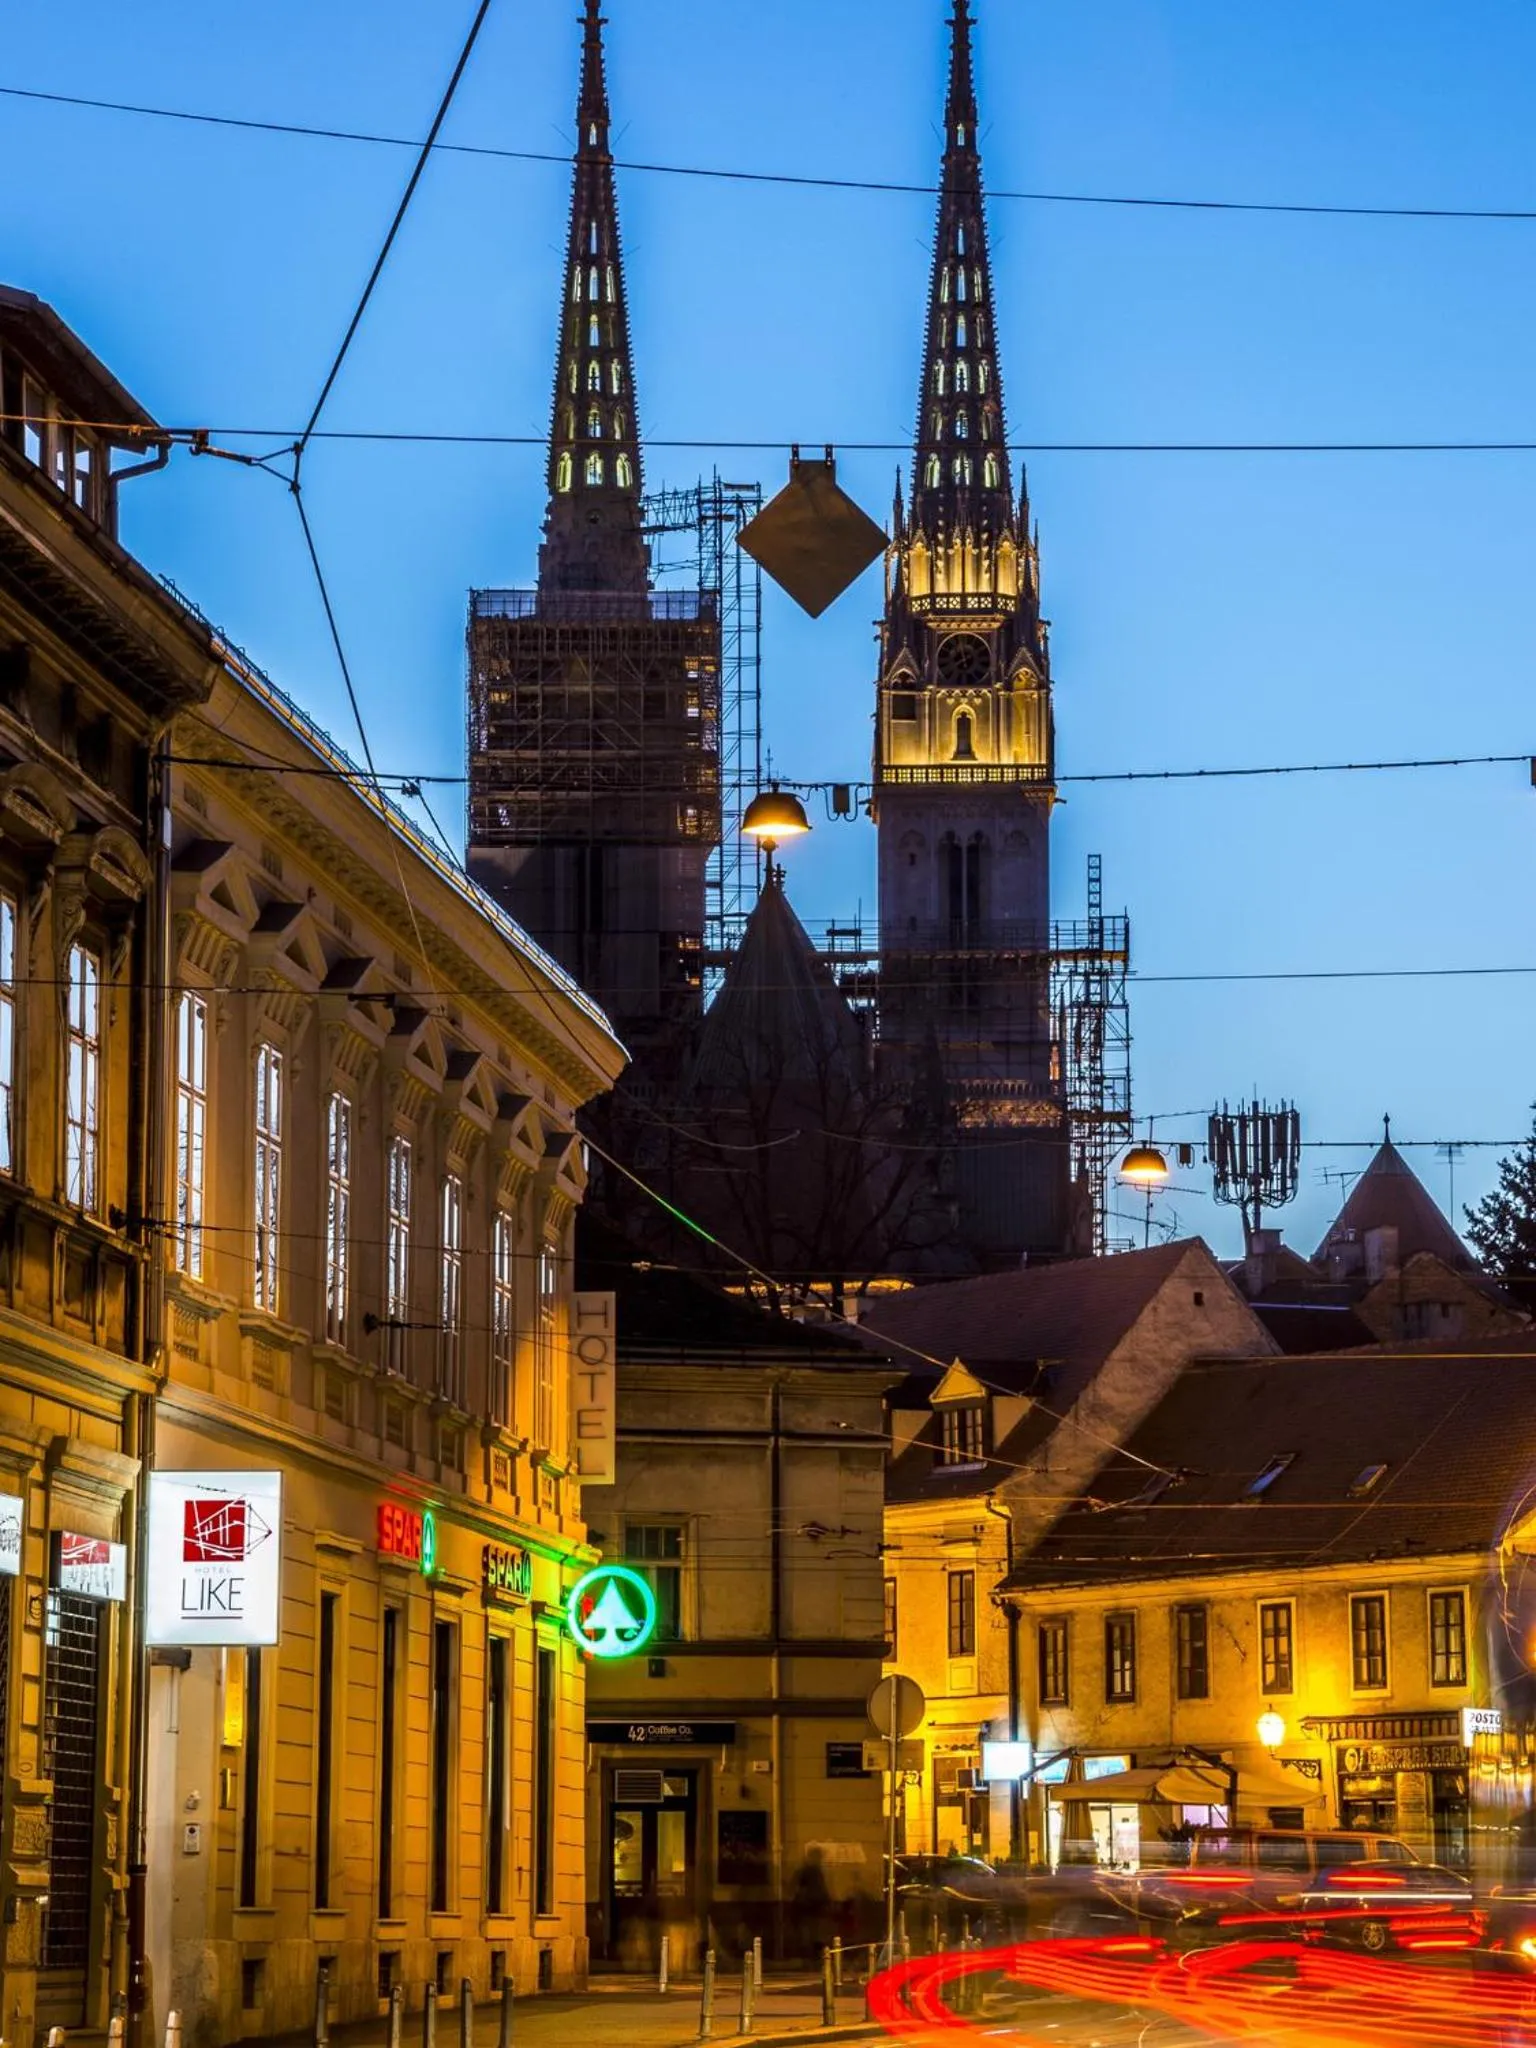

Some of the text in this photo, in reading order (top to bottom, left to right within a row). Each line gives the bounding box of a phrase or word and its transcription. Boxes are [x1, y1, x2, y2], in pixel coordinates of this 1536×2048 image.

[577, 1300, 607, 1476] HOTEL
[381, 1504, 422, 1560] SPAR
[194, 1566, 233, 1574] HOTEL
[487, 1548, 522, 1593] SPAR
[181, 1577, 245, 1611] LIKE
[628, 1725, 645, 1742] 42
[647, 1725, 677, 1735] Coffee
